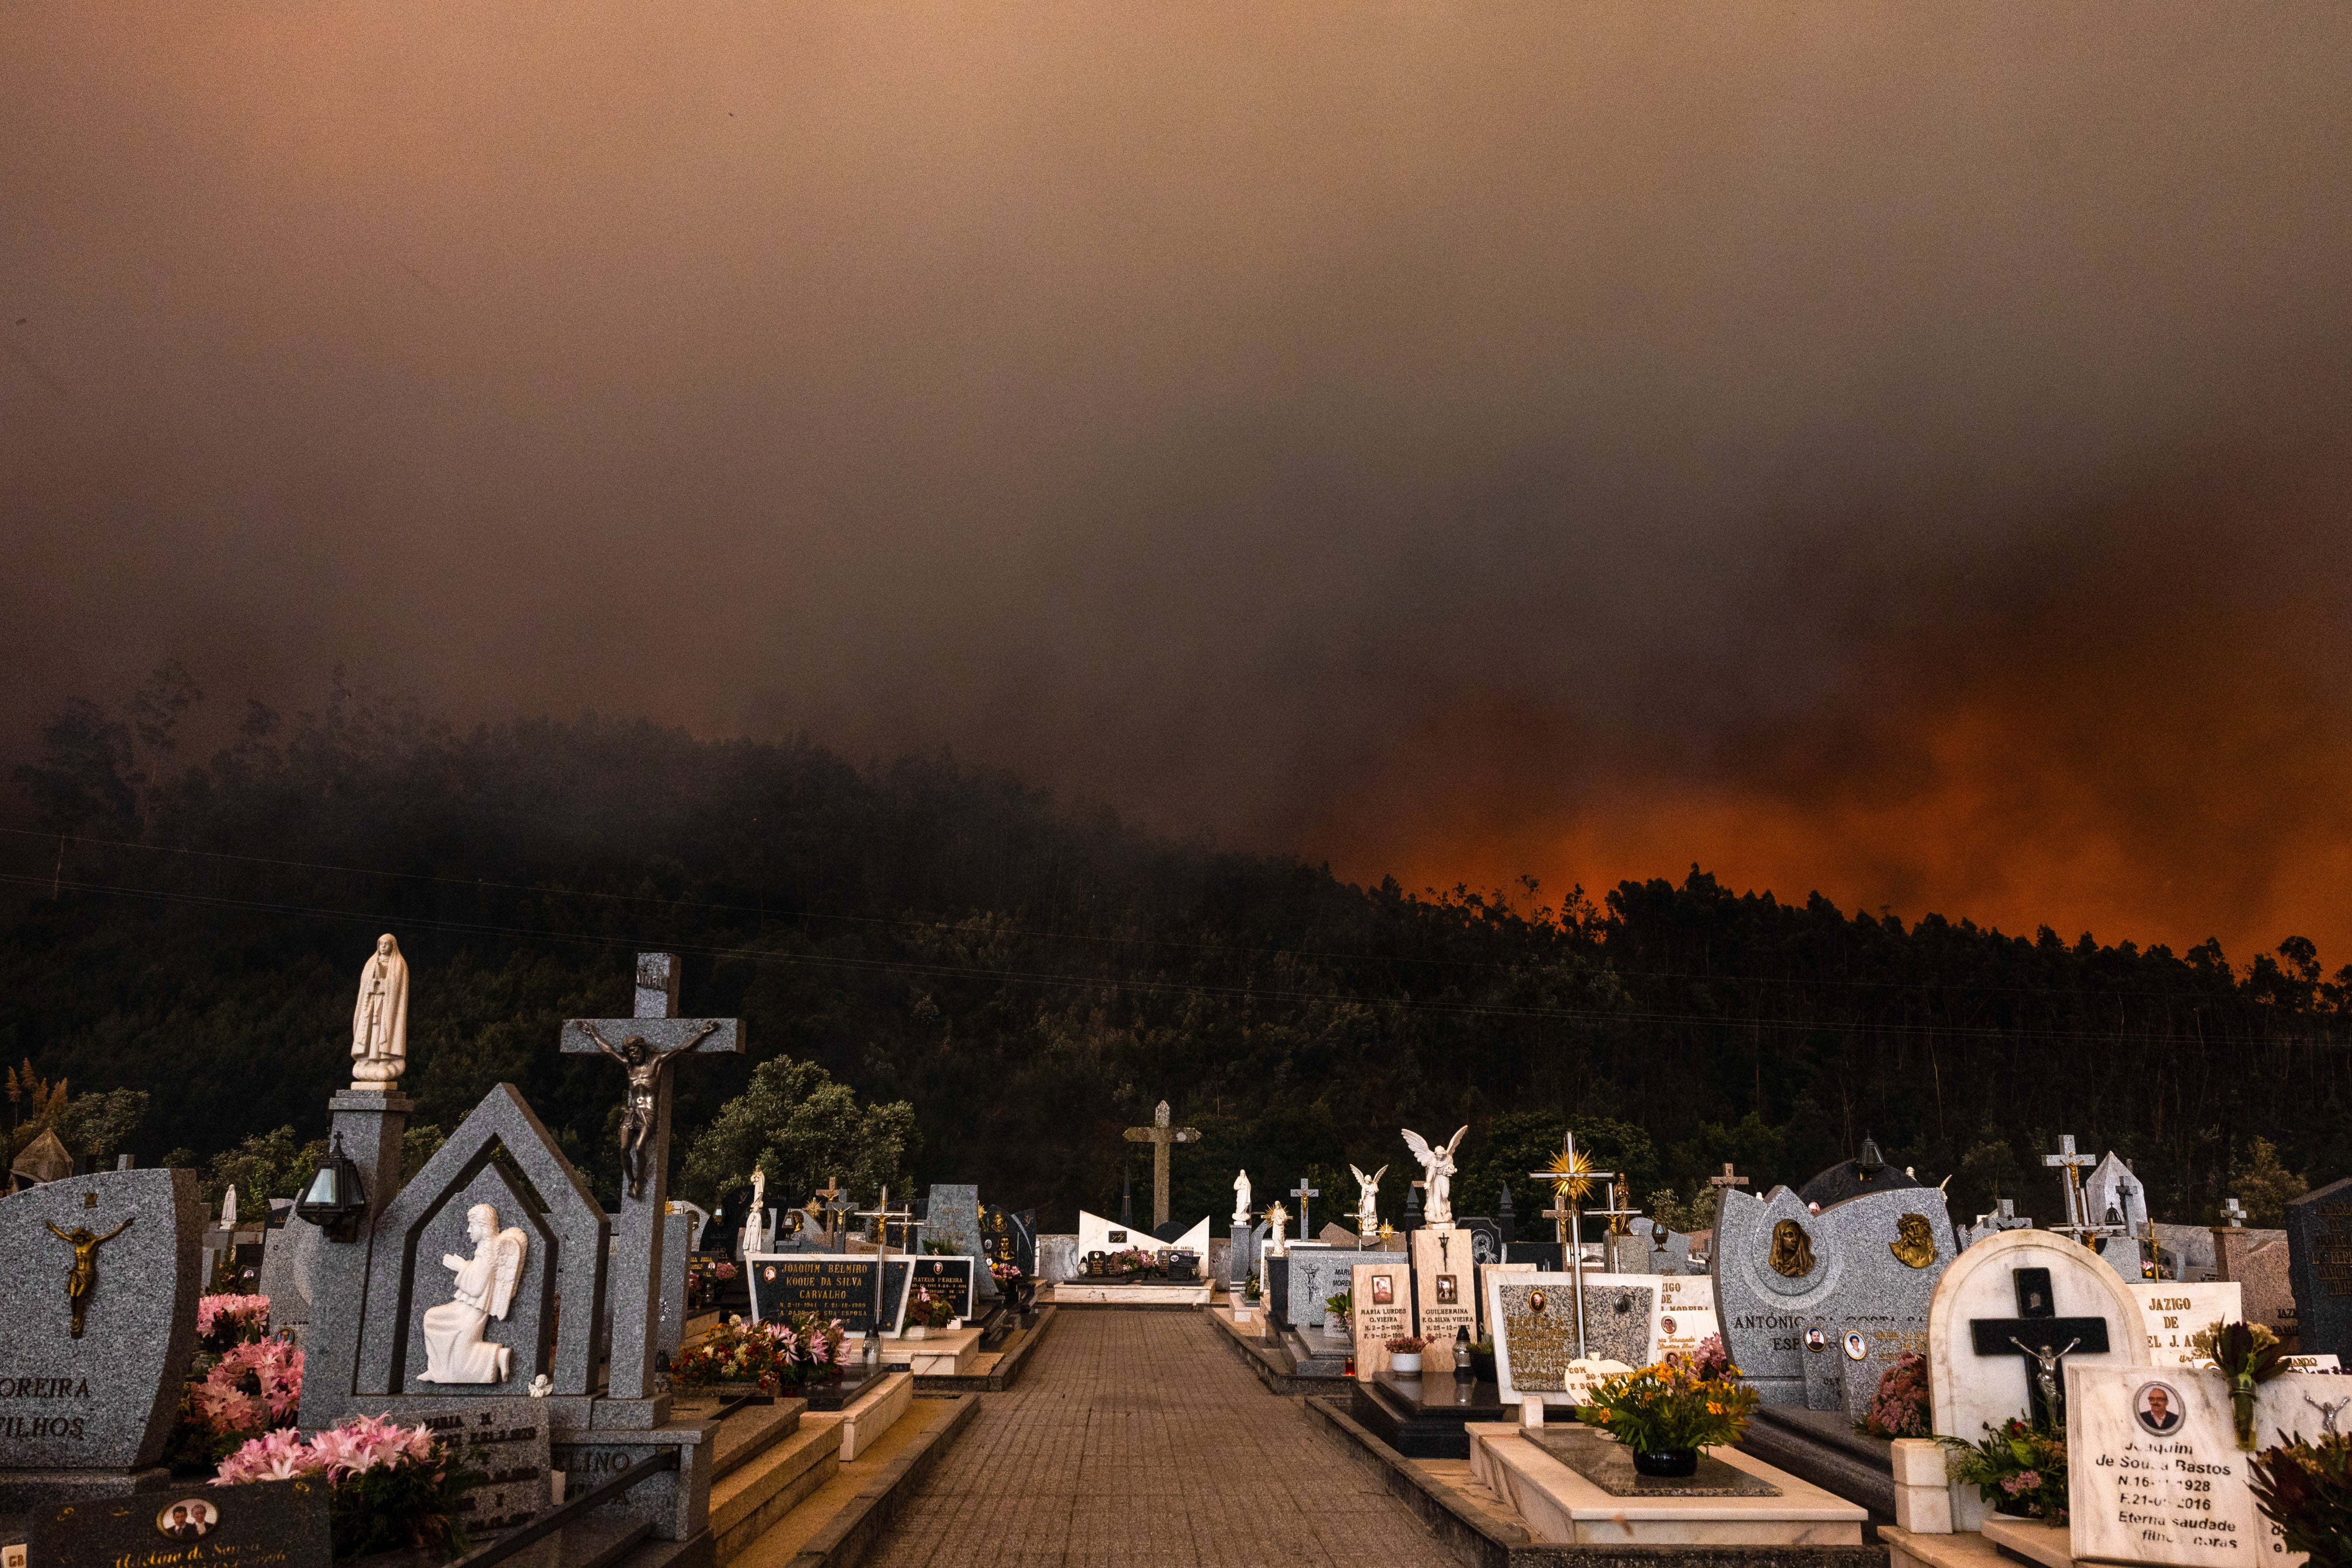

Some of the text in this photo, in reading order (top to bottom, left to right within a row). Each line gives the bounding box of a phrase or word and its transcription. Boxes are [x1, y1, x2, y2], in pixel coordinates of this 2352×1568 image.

[782, 1264, 820, 1273] JOAQUIM
[821, 1278, 832, 1286] DA
[836, 1277, 862, 1286] SILVA
[799, 1290, 847, 1299] CARVALHO
[2149, 1298, 2191, 1310] JAZIGO
[2163, 1316, 2179, 1328] DE
[2169, 1335, 2179, 1347] J.
[2120, 1456, 2168, 1470] Sou
[2119, 1511, 2236, 1532] Eterna saudade
